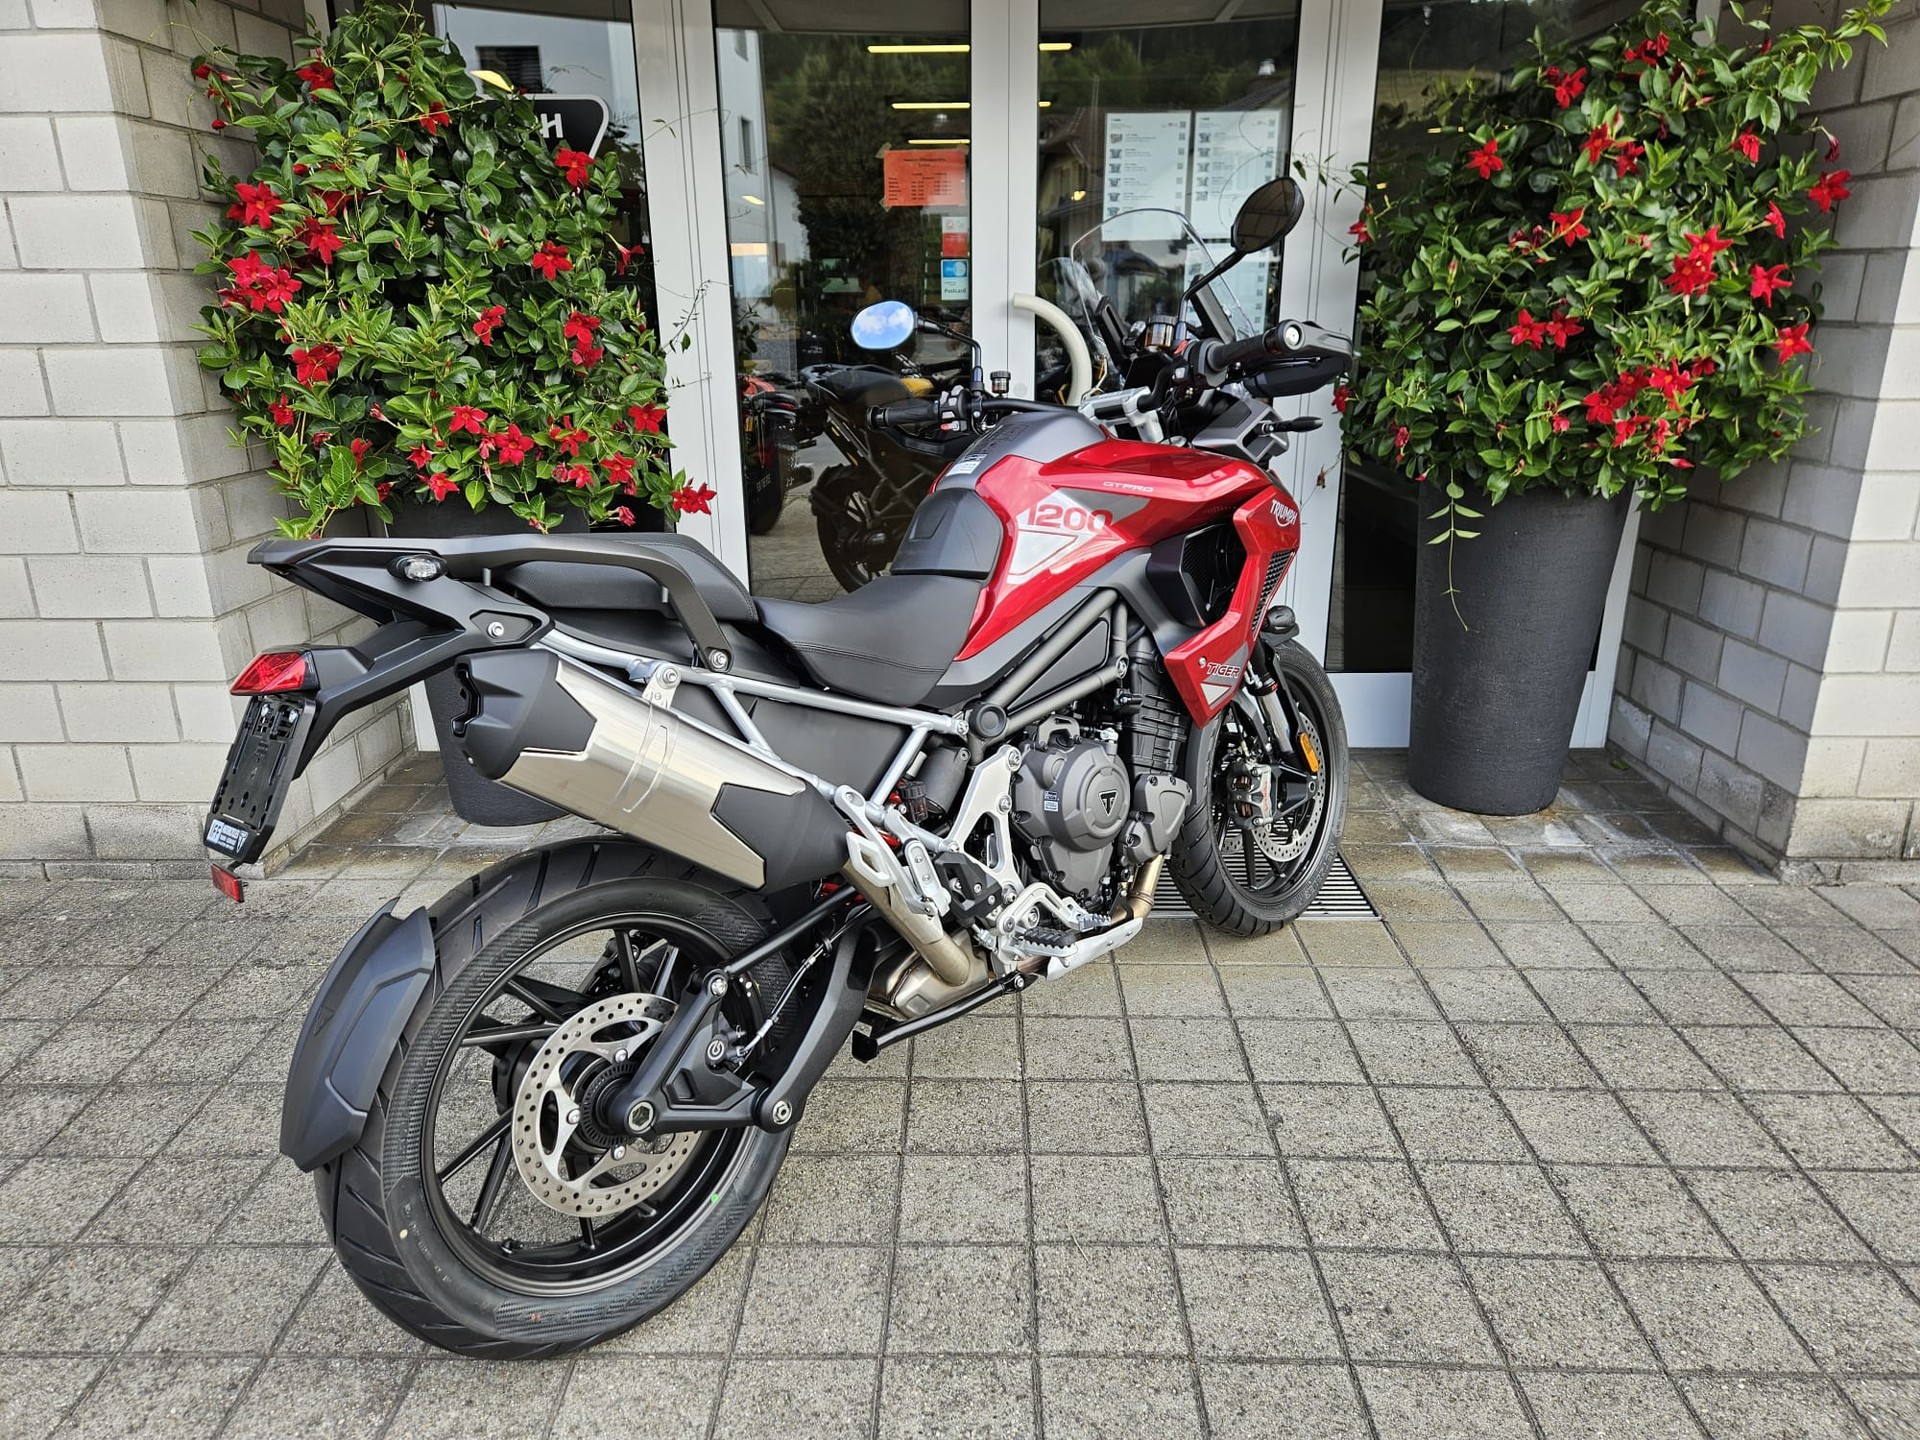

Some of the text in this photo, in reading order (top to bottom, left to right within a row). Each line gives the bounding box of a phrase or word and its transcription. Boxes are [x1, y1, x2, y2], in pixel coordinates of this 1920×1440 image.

[540, 113, 563, 138] H
[1027, 503, 1114, 535] 1200
[1270, 499, 1298, 526] TRIUMPH
[1206, 661, 1240, 679] TIGER
